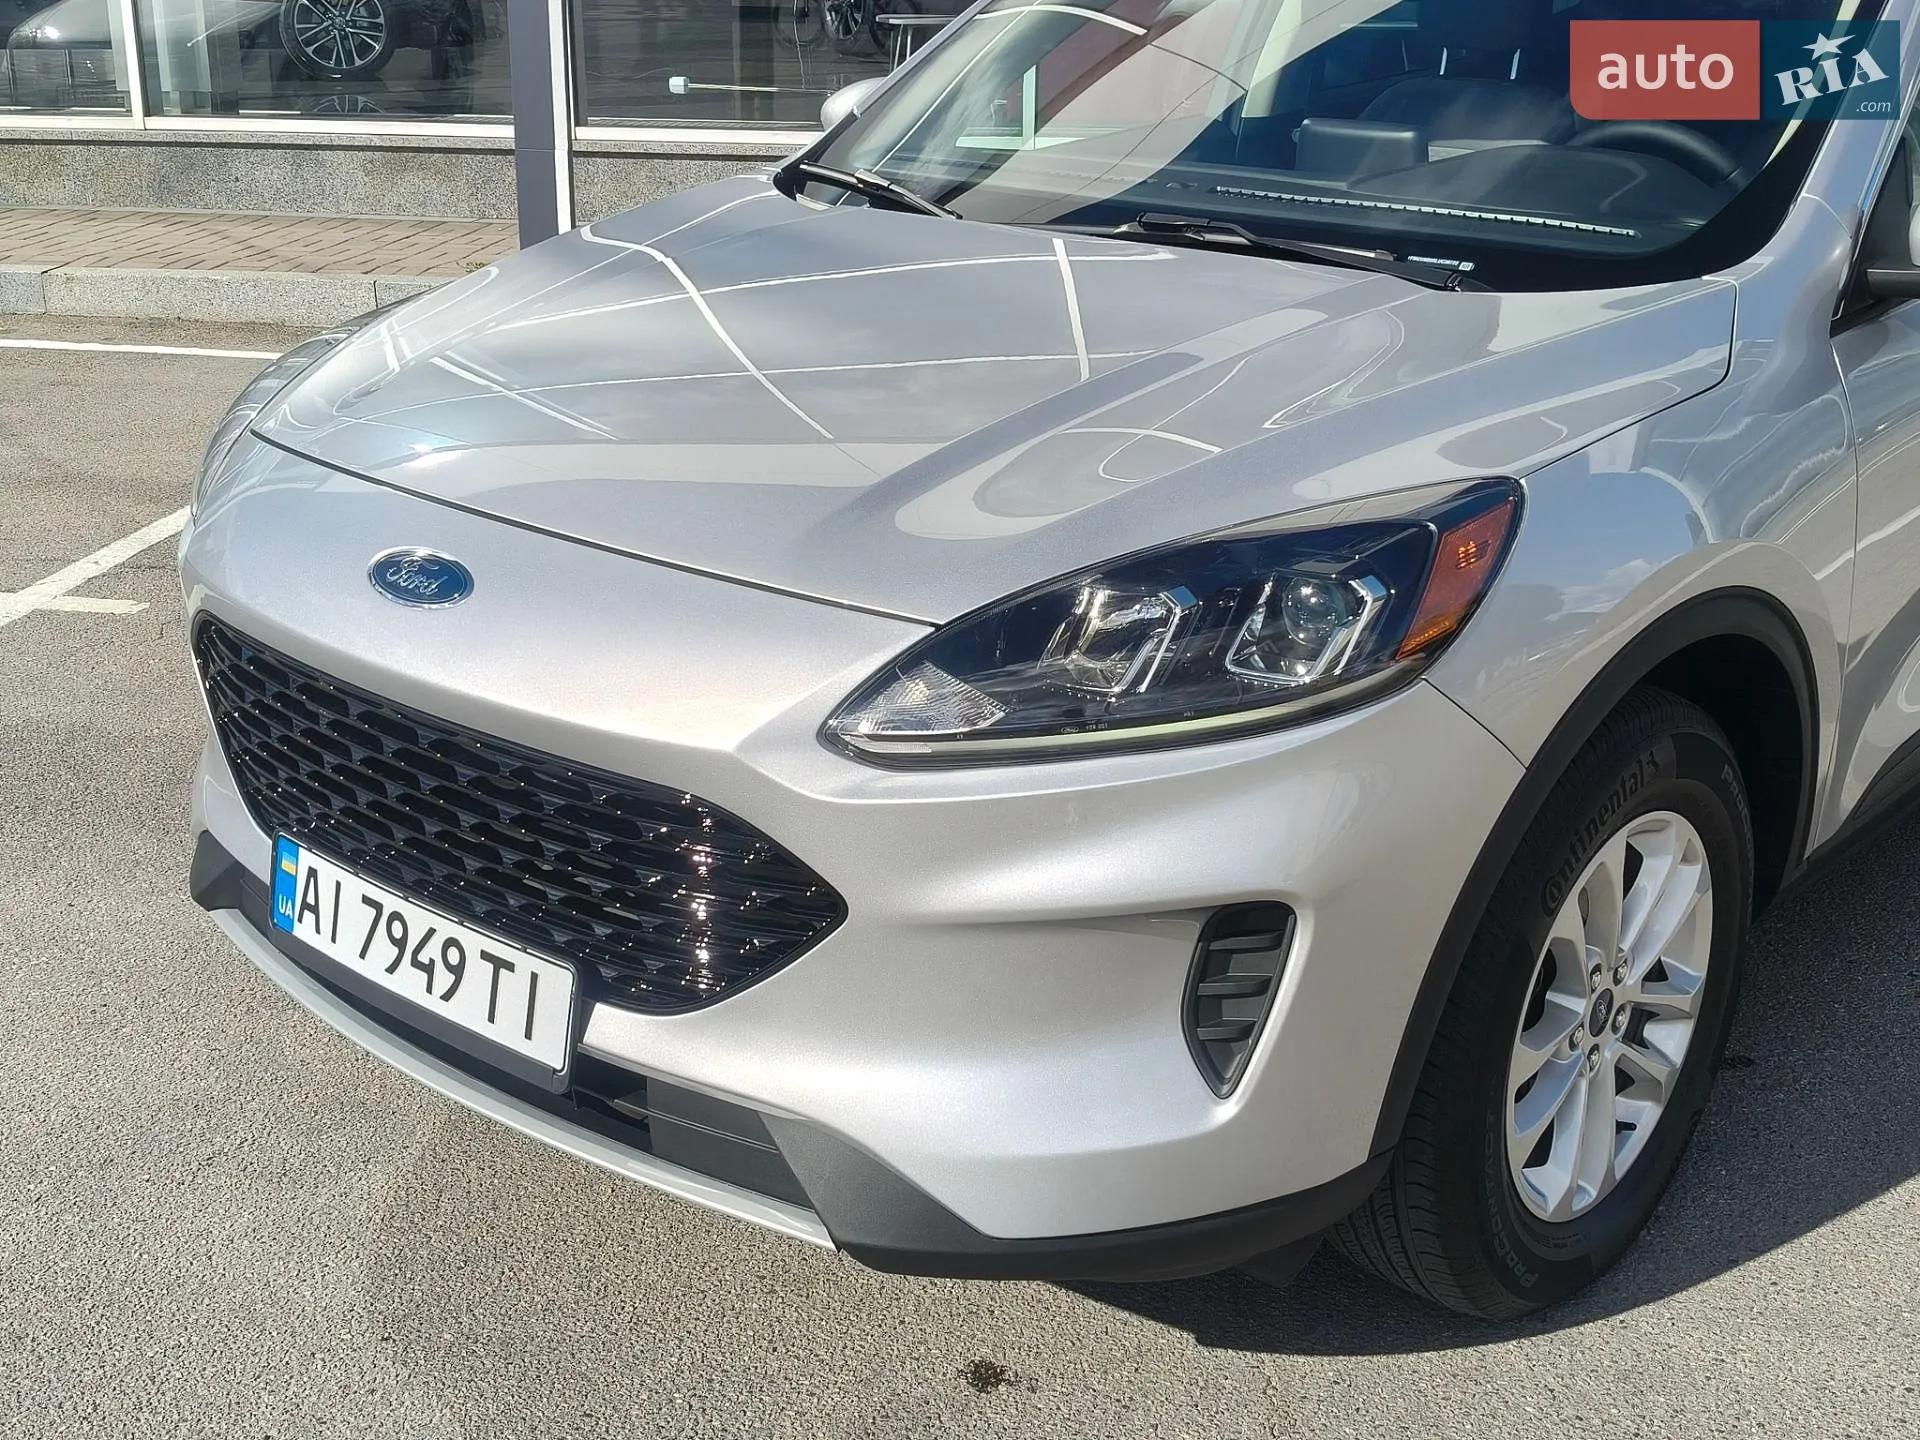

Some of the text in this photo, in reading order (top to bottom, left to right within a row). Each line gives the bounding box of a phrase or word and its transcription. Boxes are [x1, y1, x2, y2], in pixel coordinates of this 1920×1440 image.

[386, 556, 448, 596] Ford
[278, 894, 293, 920] UA
[297, 865, 539, 1041] AI 7949 TI
